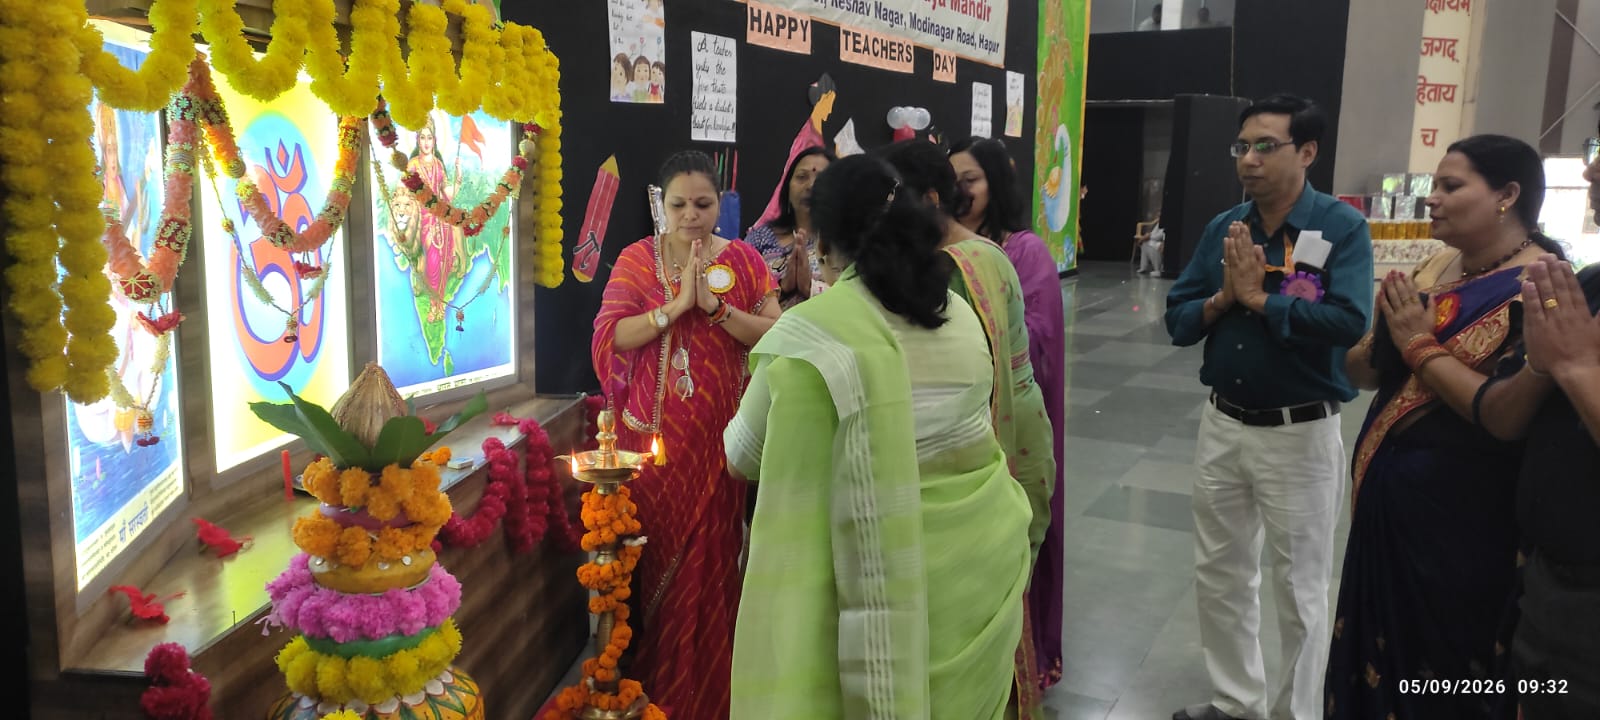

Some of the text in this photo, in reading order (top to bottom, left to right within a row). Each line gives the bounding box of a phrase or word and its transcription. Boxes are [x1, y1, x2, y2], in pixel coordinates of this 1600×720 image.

[875, 1, 906, 30] Nagar,
[909, 12, 955, 42] Modinagar
[956, 27, 977, 50] Road,
[979, 33, 1000, 54] Hapur
[950, 0, 992, 22] Mandir
[750, 7, 809, 42] HAPPY
[935, 53, 955, 73] DAY
[1420, 128, 1439, 148] च
